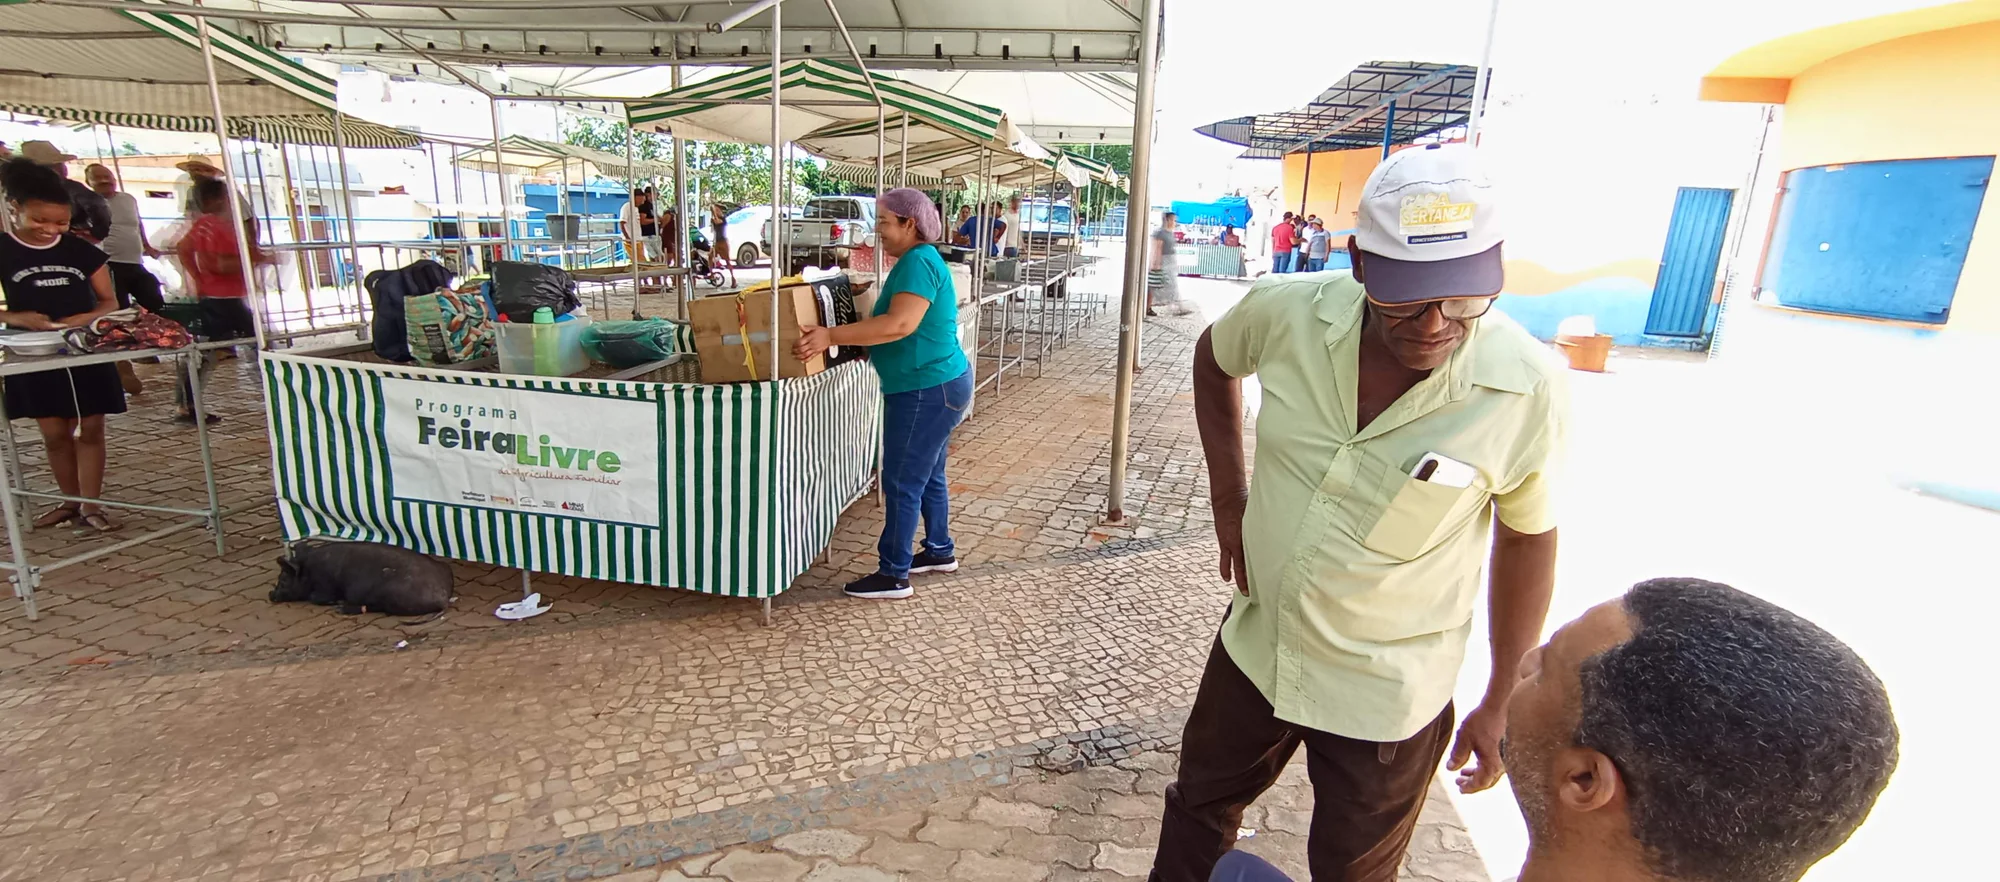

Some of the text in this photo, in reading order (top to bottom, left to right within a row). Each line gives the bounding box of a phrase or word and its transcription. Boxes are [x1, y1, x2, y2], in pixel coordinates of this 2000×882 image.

[1402, 203, 1472, 225] SERTANEJA
[36, 277, 70, 287] MODE
[415, 397, 517, 420] Programa
[512, 467, 573, 482] Agricultura
[575, 473, 621, 486] Familiar
